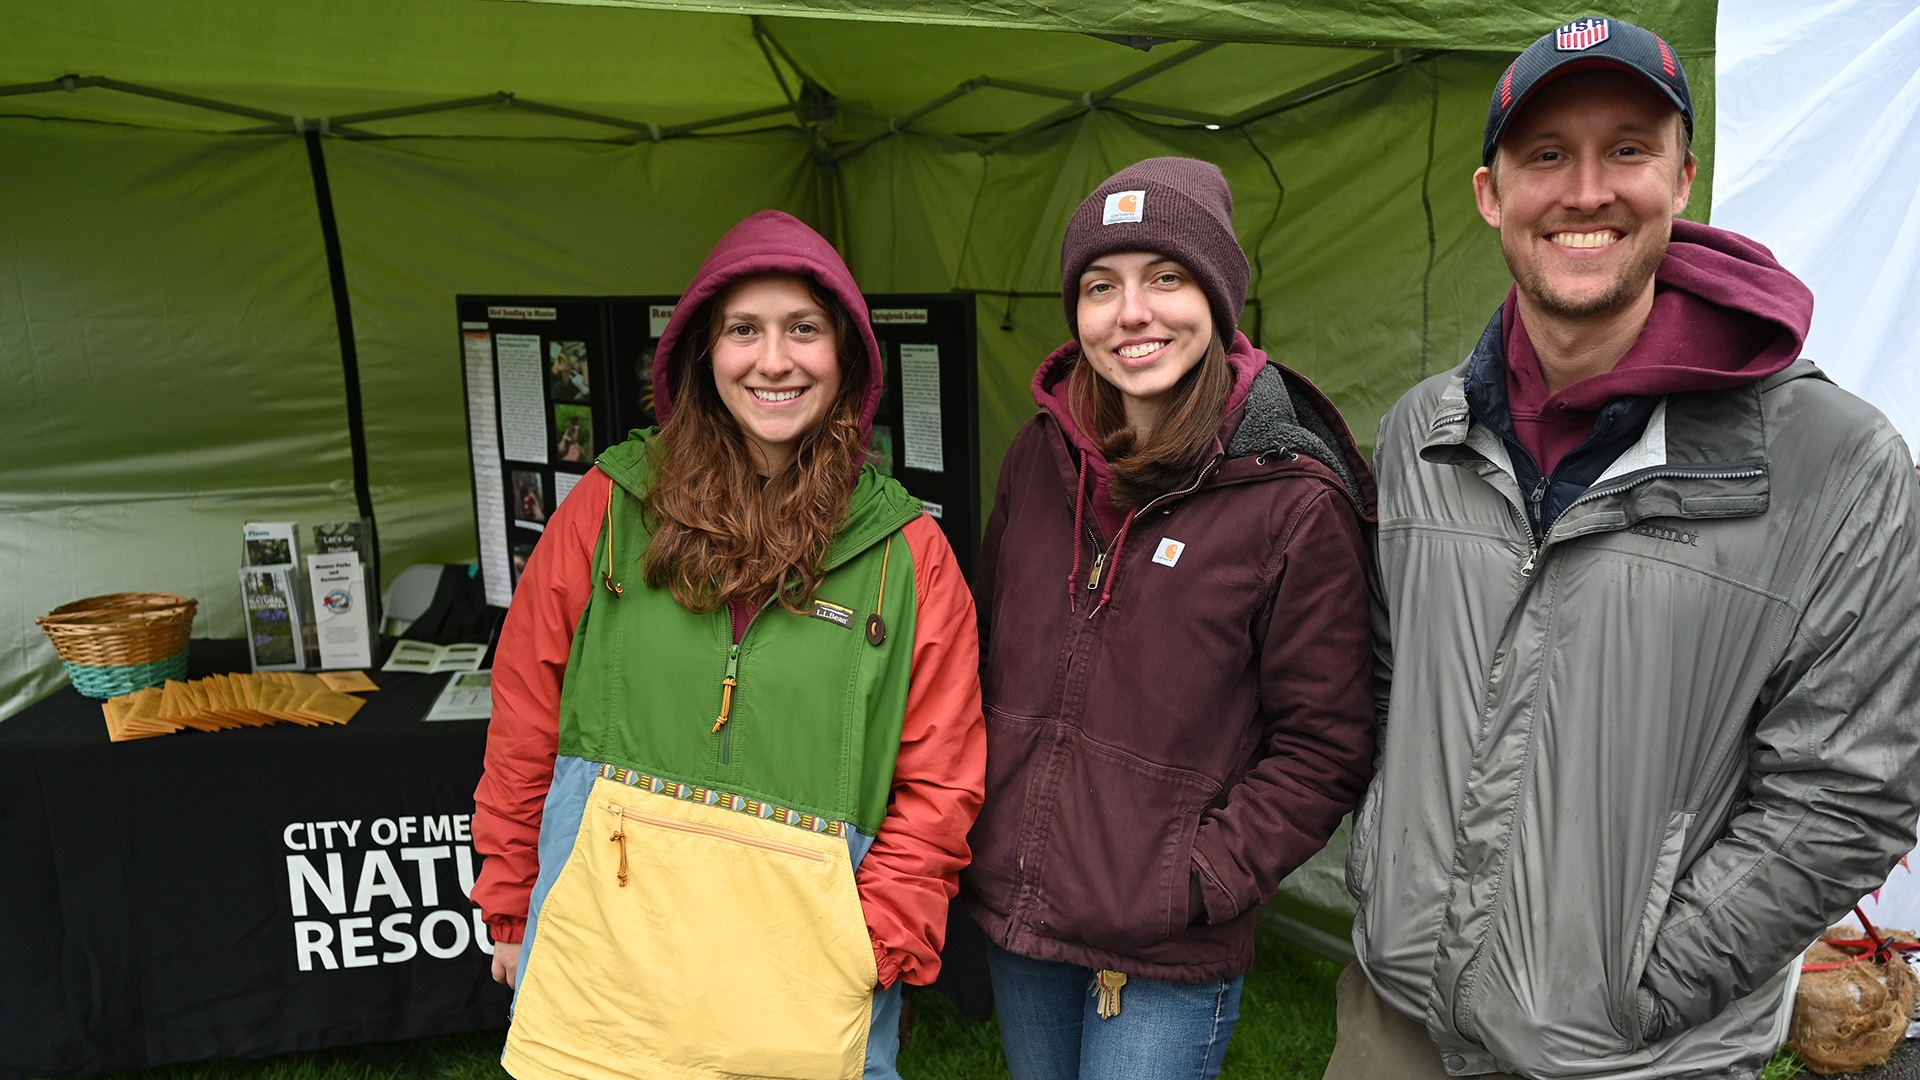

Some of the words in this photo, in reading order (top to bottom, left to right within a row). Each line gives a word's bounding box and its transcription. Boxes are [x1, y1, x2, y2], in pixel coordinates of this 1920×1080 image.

[1560, 19, 1604, 34] USA
[652, 308, 673, 318] Res
[324, 535, 342, 544] Let's
[343, 533, 355, 541] Go
[283, 820, 362, 850] CITY
[370, 816, 417, 846] OF
[423, 814, 472, 843] ME
